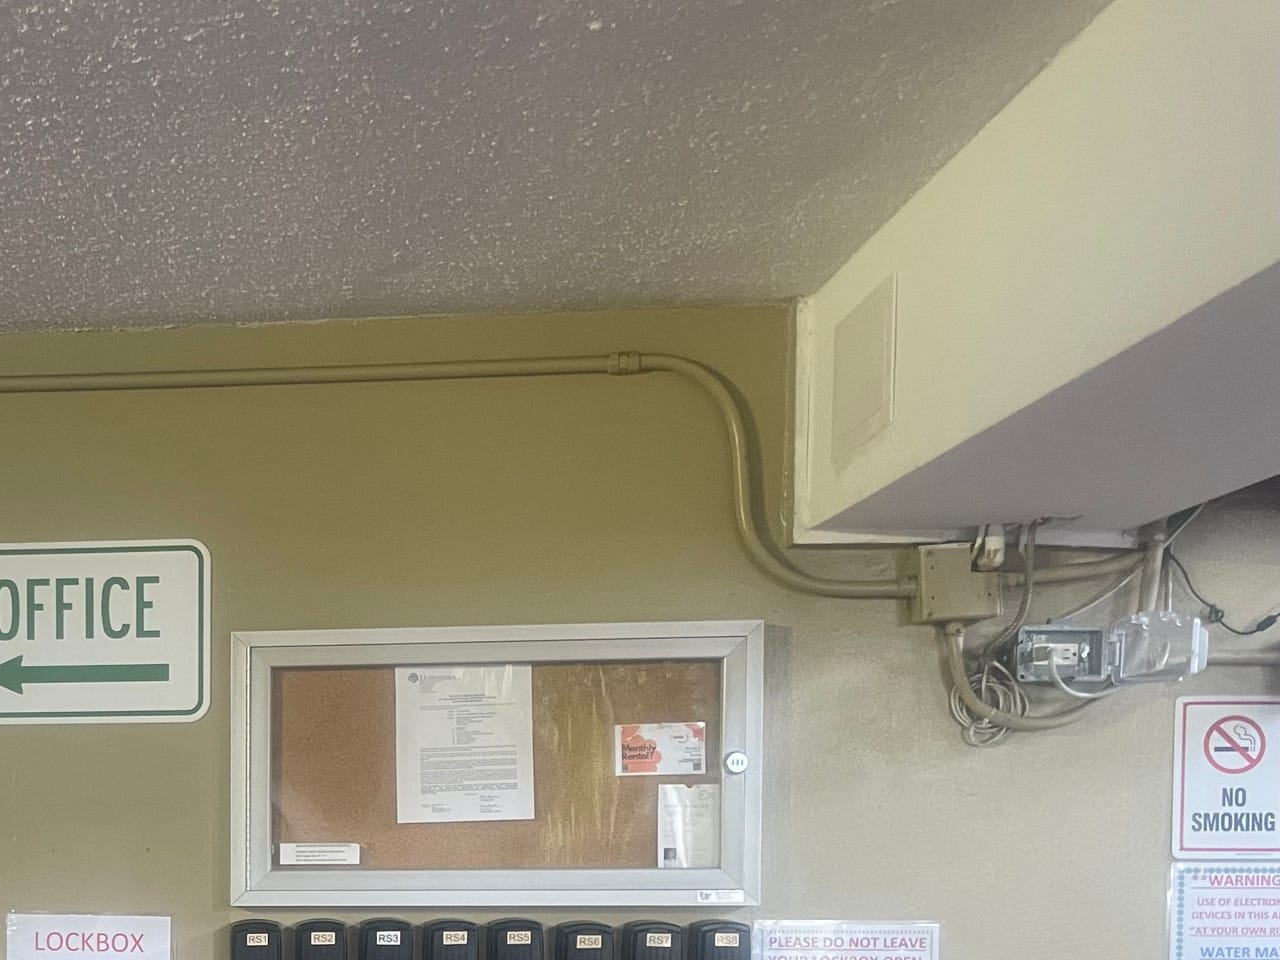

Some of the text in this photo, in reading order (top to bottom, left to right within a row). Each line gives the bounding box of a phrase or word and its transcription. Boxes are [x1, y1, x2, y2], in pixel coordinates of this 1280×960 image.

[622, 743, 657, 754] Monthly
[622, 751, 655, 761] Rental?
[1222, 787, 1247, 807] NO
[1191, 812, 1276, 832] SMOKING
[1197, 897, 1215, 906] USE
[1218, 898, 1230, 906] OF
[1192, 911, 1232, 920] DEVICES
[1234, 911, 1245, 920] IN
[1247, 911, 1269, 920] THIS
[1210, 927, 1238, 935] YOUR
[1241, 927, 1267, 935] OWN
[35, 931, 144, 953] LOCKBOX
[248, 934, 267, 944] RS1
[313, 934, 334, 944] RS2
[378, 933, 399, 943] RS3
[445, 933, 465, 943] RS4
[509, 933, 530, 943] RS5
[579, 936, 600, 946] RS6
[649, 935, 670, 945] RS7
[717, 935, 738, 945] RS8
[769, 936, 927, 949] PLEASE DO NOT LEAVE
[1200, 946, 1280, 958] WATER MA
